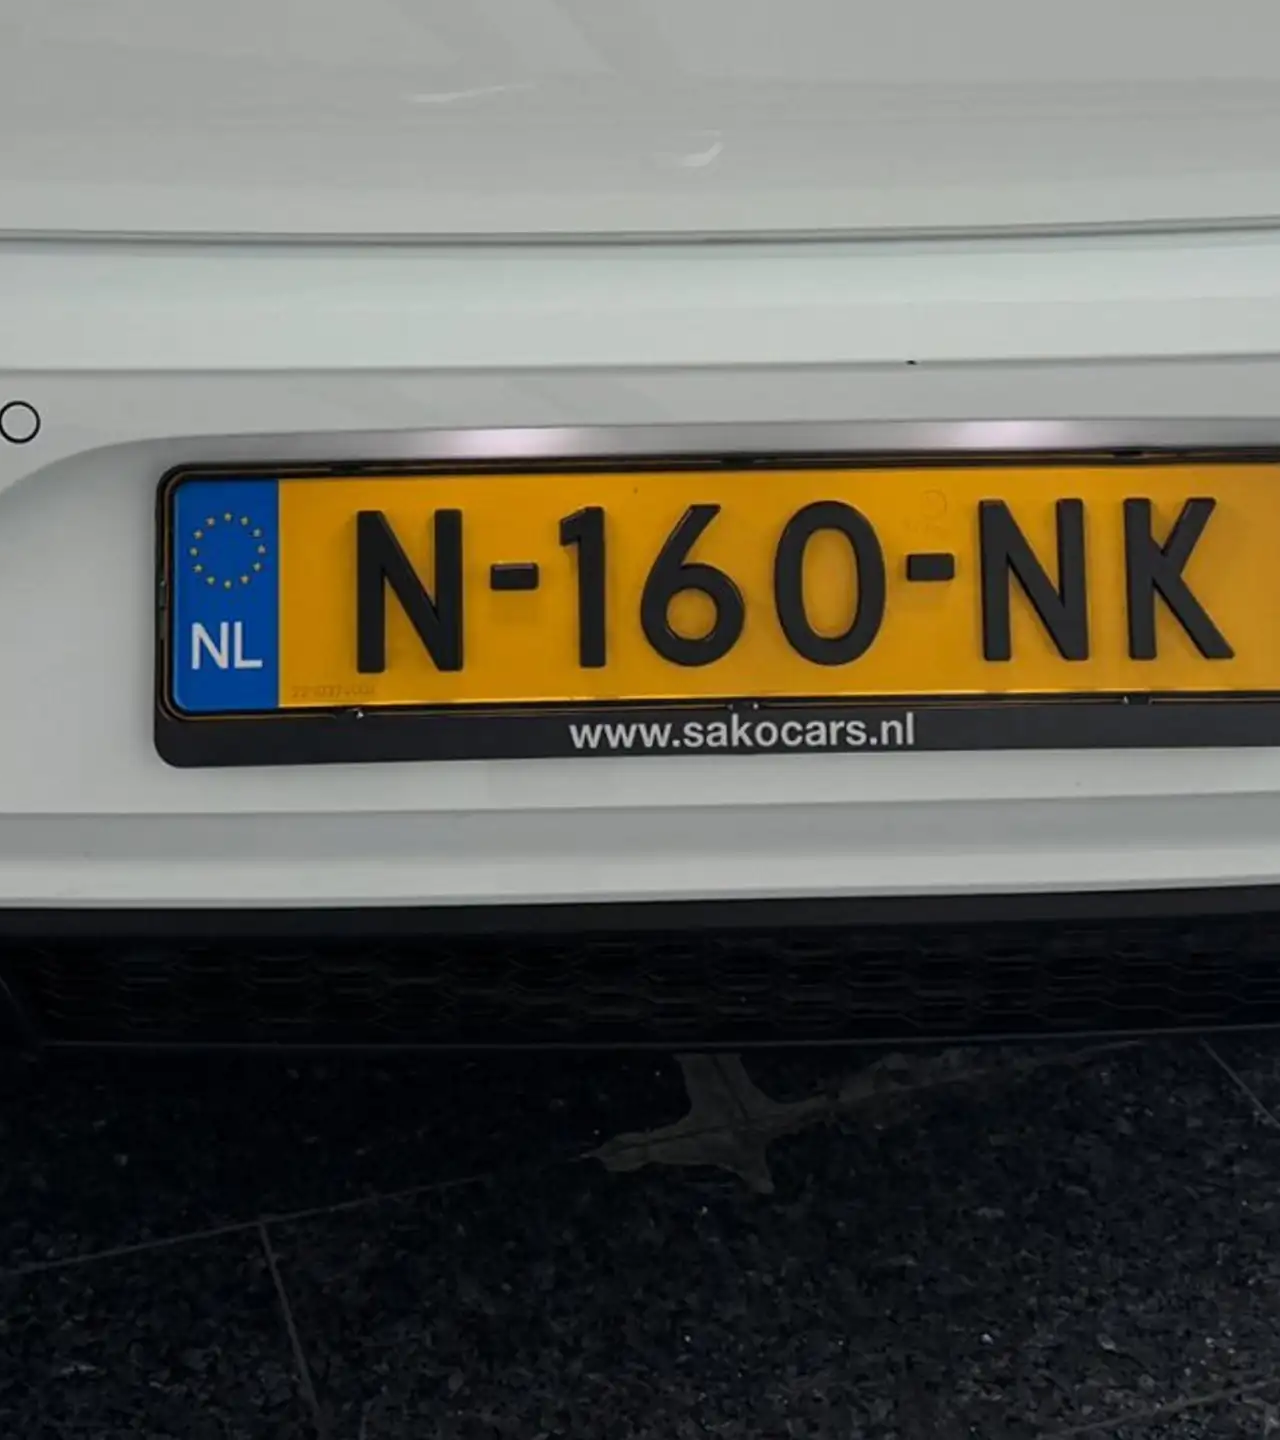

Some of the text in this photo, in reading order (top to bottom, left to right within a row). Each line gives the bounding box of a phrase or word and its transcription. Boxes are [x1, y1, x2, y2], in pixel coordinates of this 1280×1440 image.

[355, 497, 1236, 674] N-160-NK
[190, 620, 264, 671] NL
[568, 711, 916, 750] www.sakocars.nl
